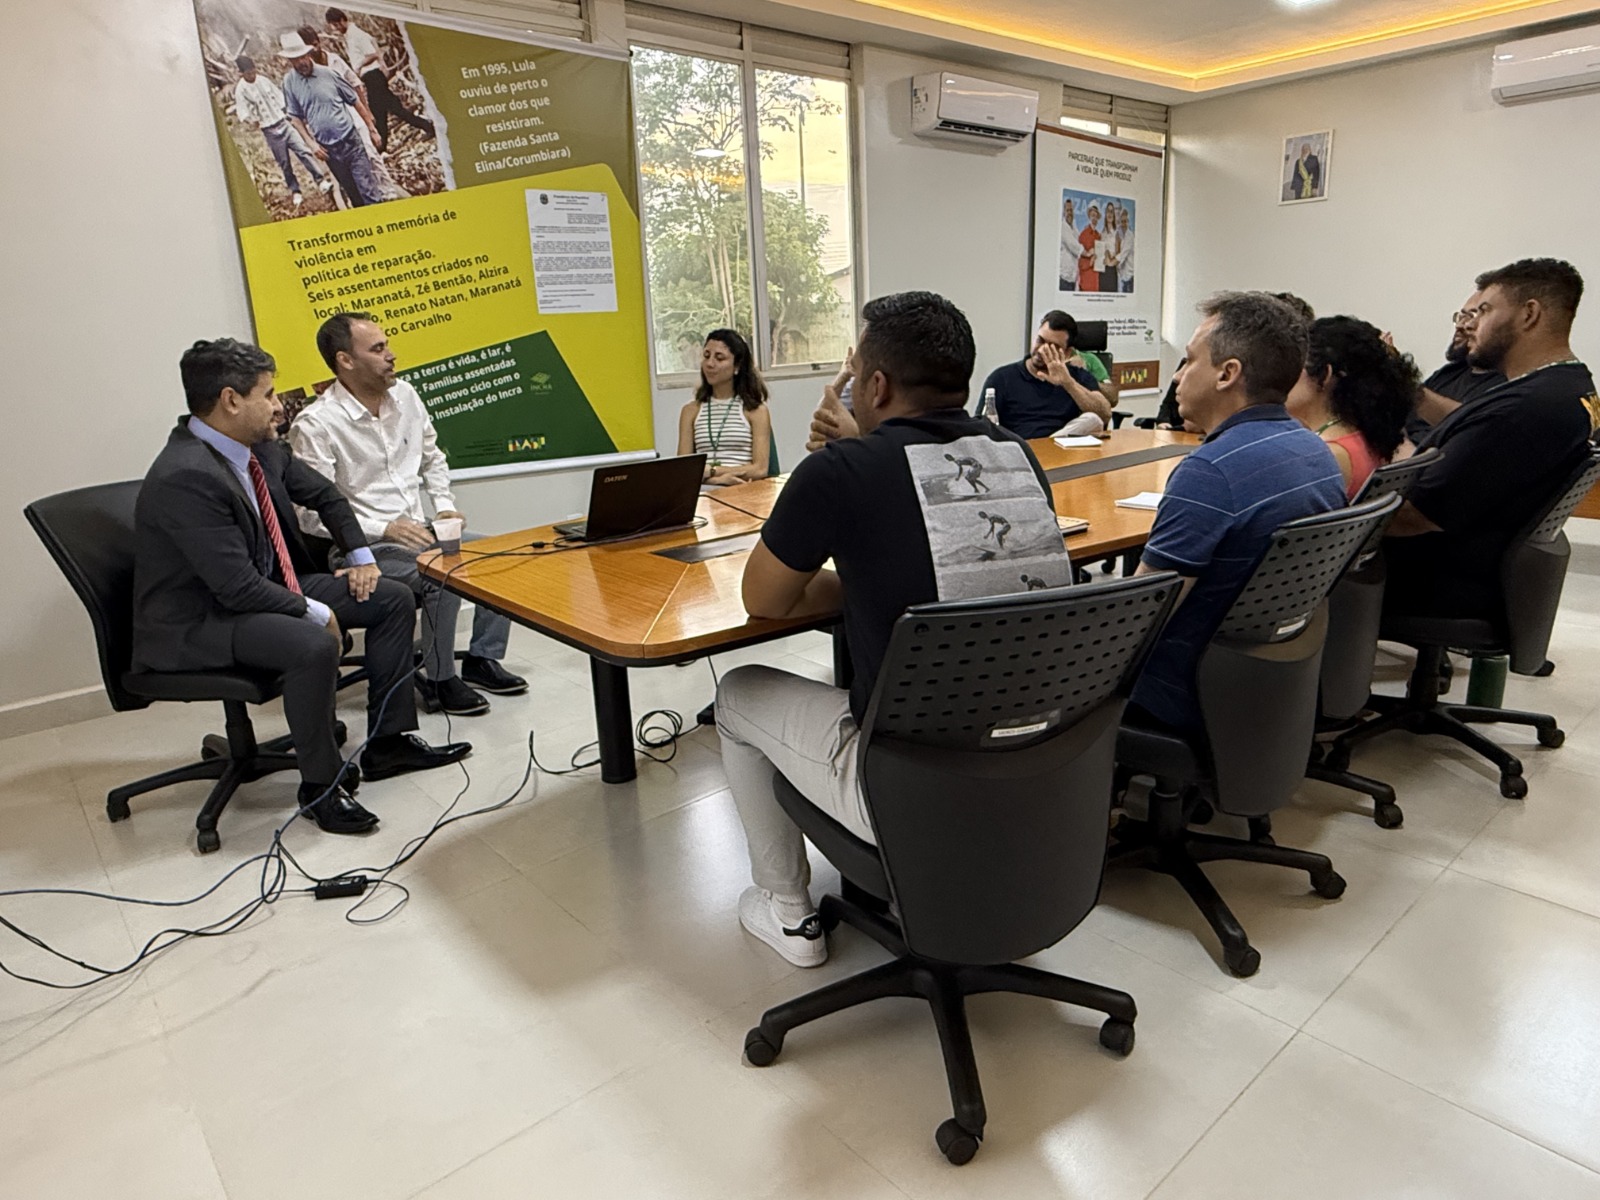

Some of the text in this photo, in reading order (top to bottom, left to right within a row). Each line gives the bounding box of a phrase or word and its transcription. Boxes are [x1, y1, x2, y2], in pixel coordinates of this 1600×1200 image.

[461, 60, 536, 78] Em 1995, Lula
[460, 78, 548, 98] ouviu de perto o
[468, 96, 550, 117] clamor dos que
[486, 116, 544, 134] resistiram.
[479, 132, 559, 156] (Fazenda Santa
[474, 146, 571, 173] Elina/Corumbiara)
[1068, 152, 1138, 172] PARCERIAS QUE TRANSFORMAM
[1081, 166, 1092, 174] VIDA
[1100, 169, 1112, 178] QUEM
[1114, 172, 1132, 182] PRODUZ
[287, 210, 457, 252] Transformou a memória de
[294, 244, 377, 268] violência em
[302, 250, 436, 290] política de reparação.
[308, 254, 489, 304] Seis assentamentos criados no
[351, 287, 414, 310] Maranatá,
[416, 282, 431, 295] Zé
[432, 274, 476, 291] Bentão,
[479, 266, 509, 280] Alzira
[384, 302, 426, 320] Renato
[429, 293, 468, 309] Natan,
[469, 276, 522, 298] Maranatá
[400, 312, 452, 332] Carvalho
[414, 371, 420, 380] a
[421, 364, 446, 377] terra
[448, 360, 455, 370] é
[456, 353, 480, 368] vida,
[480, 349, 488, 360] é
[489, 346, 504, 358] lar,
[505, 343, 512, 352] é
[422, 376, 464, 392] Famílias
[464, 358, 516, 380] assentadas
[427, 396, 444, 406] um
[445, 388, 469, 402] novo
[470, 380, 492, 394] ciclo
[493, 376, 512, 386] com
[435, 398, 484, 420] Instalação
[486, 394, 498, 406] do
[500, 386, 522, 399] Incra
